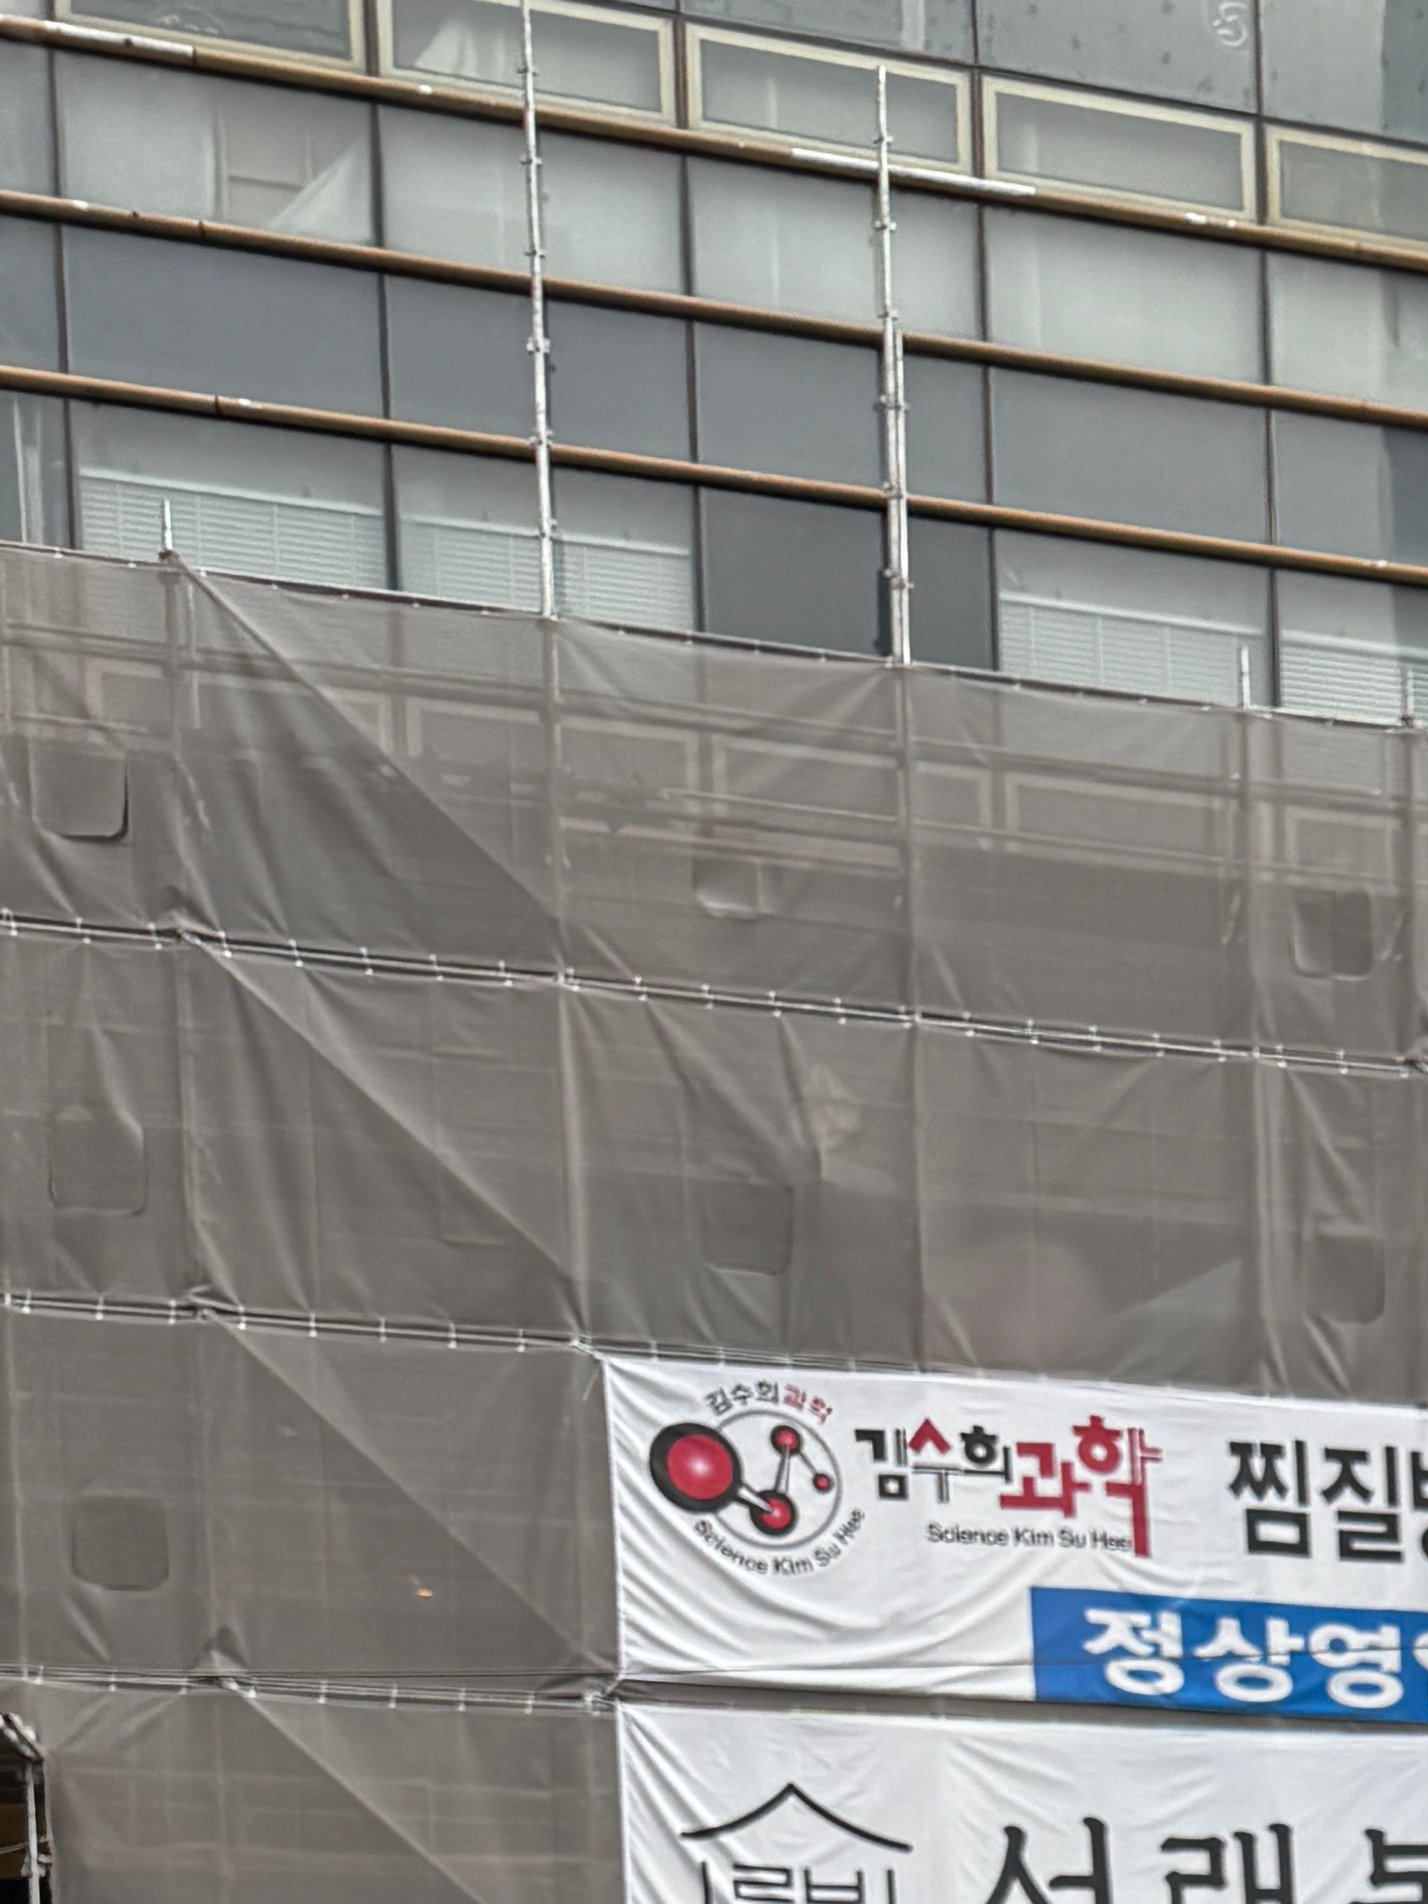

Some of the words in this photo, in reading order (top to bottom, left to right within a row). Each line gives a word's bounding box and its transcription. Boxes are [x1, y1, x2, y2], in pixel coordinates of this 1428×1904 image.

[854, 1414, 1163, 1559] 김수희과학
[694, 1519, 769, 1575] Science
[772, 1557, 815, 1576] Kim
[814, 1543, 842, 1567] Su
[833, 1508, 865, 1545] Hee
[927, 1522, 1009, 1546] Science
[1014, 1527, 1055, 1547] Kim
[1060, 1528, 1088, 1549] Su
